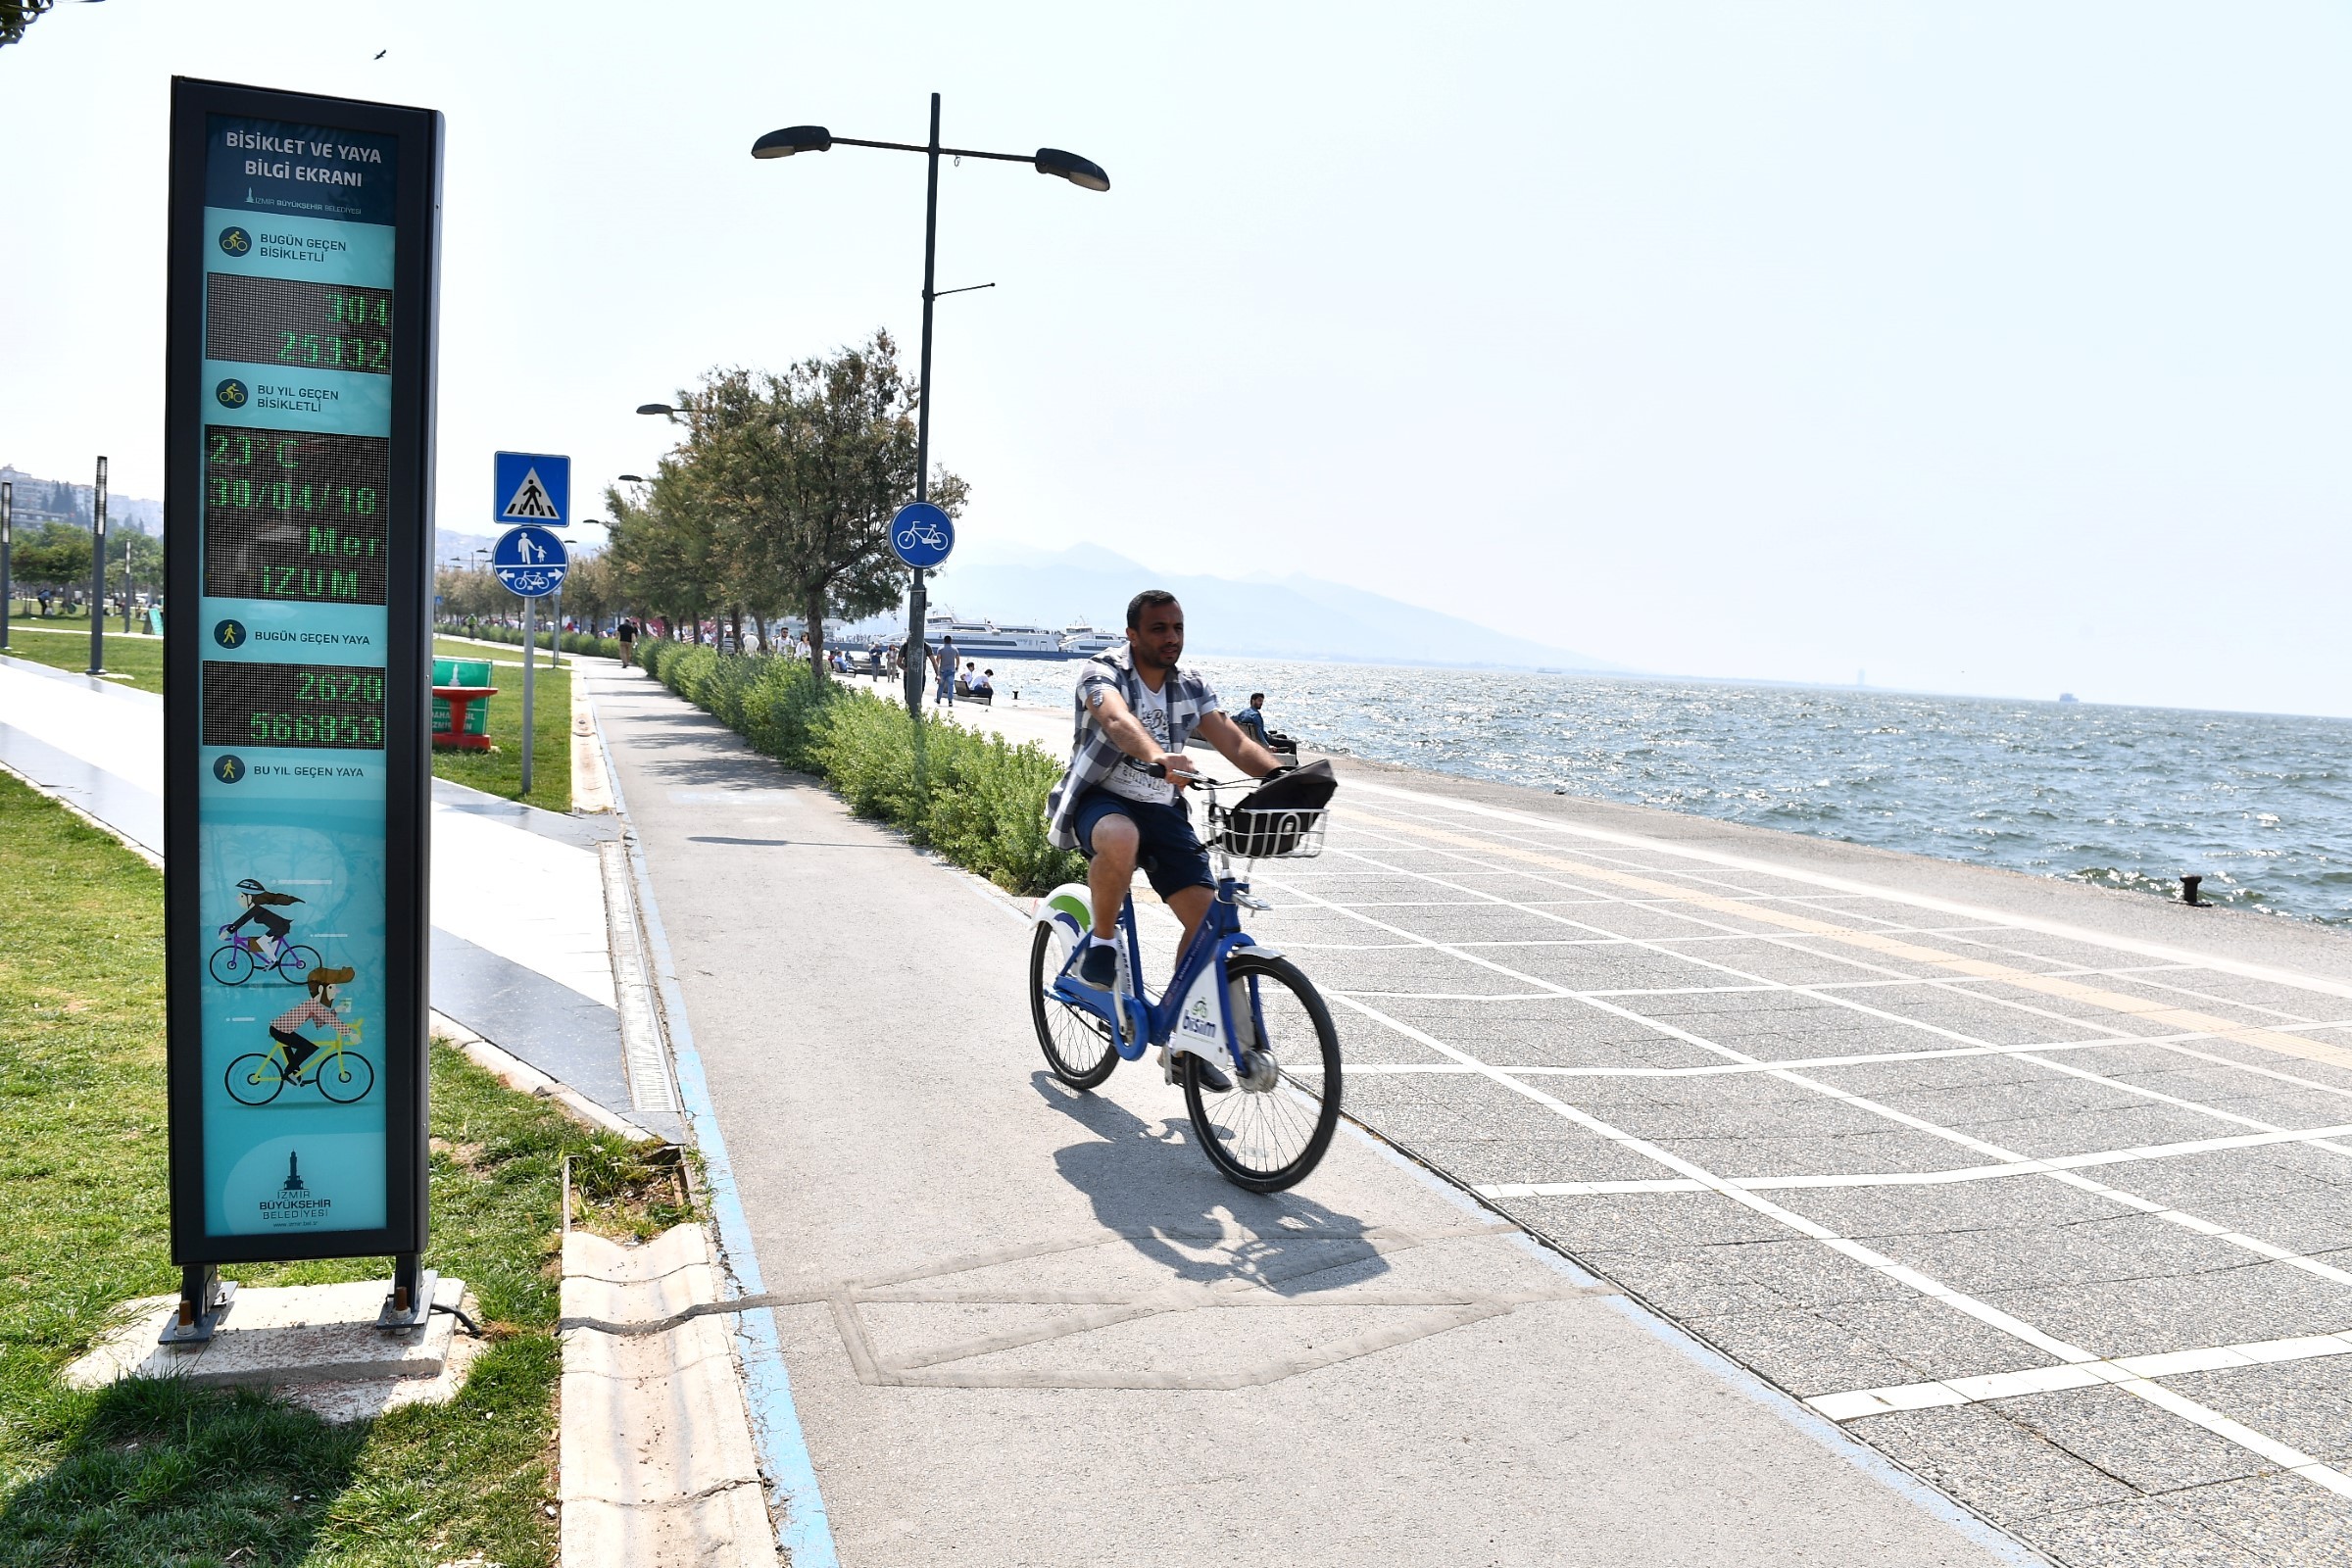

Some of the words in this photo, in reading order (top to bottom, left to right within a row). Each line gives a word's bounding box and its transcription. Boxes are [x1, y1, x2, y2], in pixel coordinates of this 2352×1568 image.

[226, 130, 305, 155] BİSİKLET
[310, 142, 332, 158] VE
[337, 144, 382, 164] YAYA
[245, 159, 290, 179] BİLGİ
[296, 166, 363, 187] EKRANI
[260, 233, 303, 247] BUGÜN
[306, 238, 346, 252] GEÇEN
[260, 246, 324, 263] BİSİKLETLİ
[325, 293, 388, 326] 304
[277, 330, 388, 368] 25332
[257, 397, 321, 413] BİSİKLETLİ
[258, 384, 274, 395] BU
[277, 386, 295, 397] YIL
[298, 387, 339, 402] GEÇEN
[209, 477, 376, 514] 30/04/18
[309, 525, 380, 559] Mer
[255, 630, 297, 642] BUGÜN
[300, 633, 339, 646] GEÇEN
[342, 635, 370, 645] YAYA
[296, 672, 382, 703] 2628
[250, 712, 382, 744] 566853
[254, 765, 270, 775] BU
[272, 765, 291, 776] YIL
[294, 766, 333, 778] GEÇEN
[336, 767, 364, 777] YAYA
